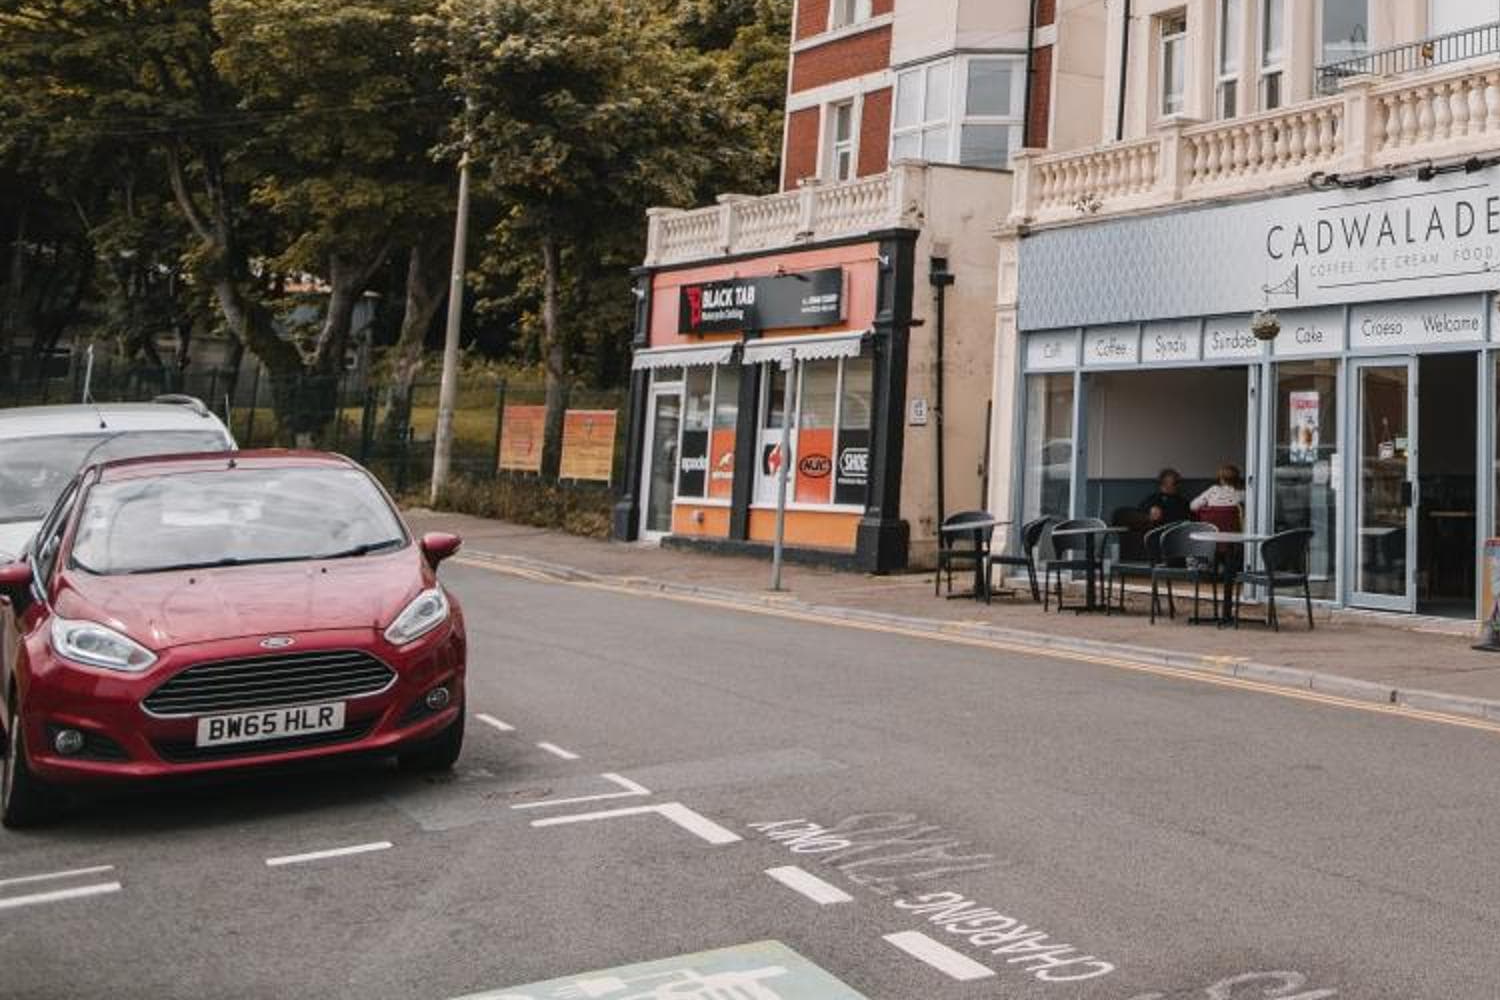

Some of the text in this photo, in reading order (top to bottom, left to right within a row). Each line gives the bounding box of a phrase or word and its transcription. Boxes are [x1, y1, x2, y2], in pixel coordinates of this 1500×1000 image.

[1310, 245, 1494, 278] COFFEE ICE CREAM FOOD
[702, 286, 756, 309] BLACK TAB
[1295, 326, 1324, 344] Cake
[1361, 312, 1480, 337] Croeso Welcome
[1095, 335, 1127, 357] Coffee
[208, 706, 334, 741] BW65 HLR
[748, 818, 1115, 982] CHARGING ONLY
